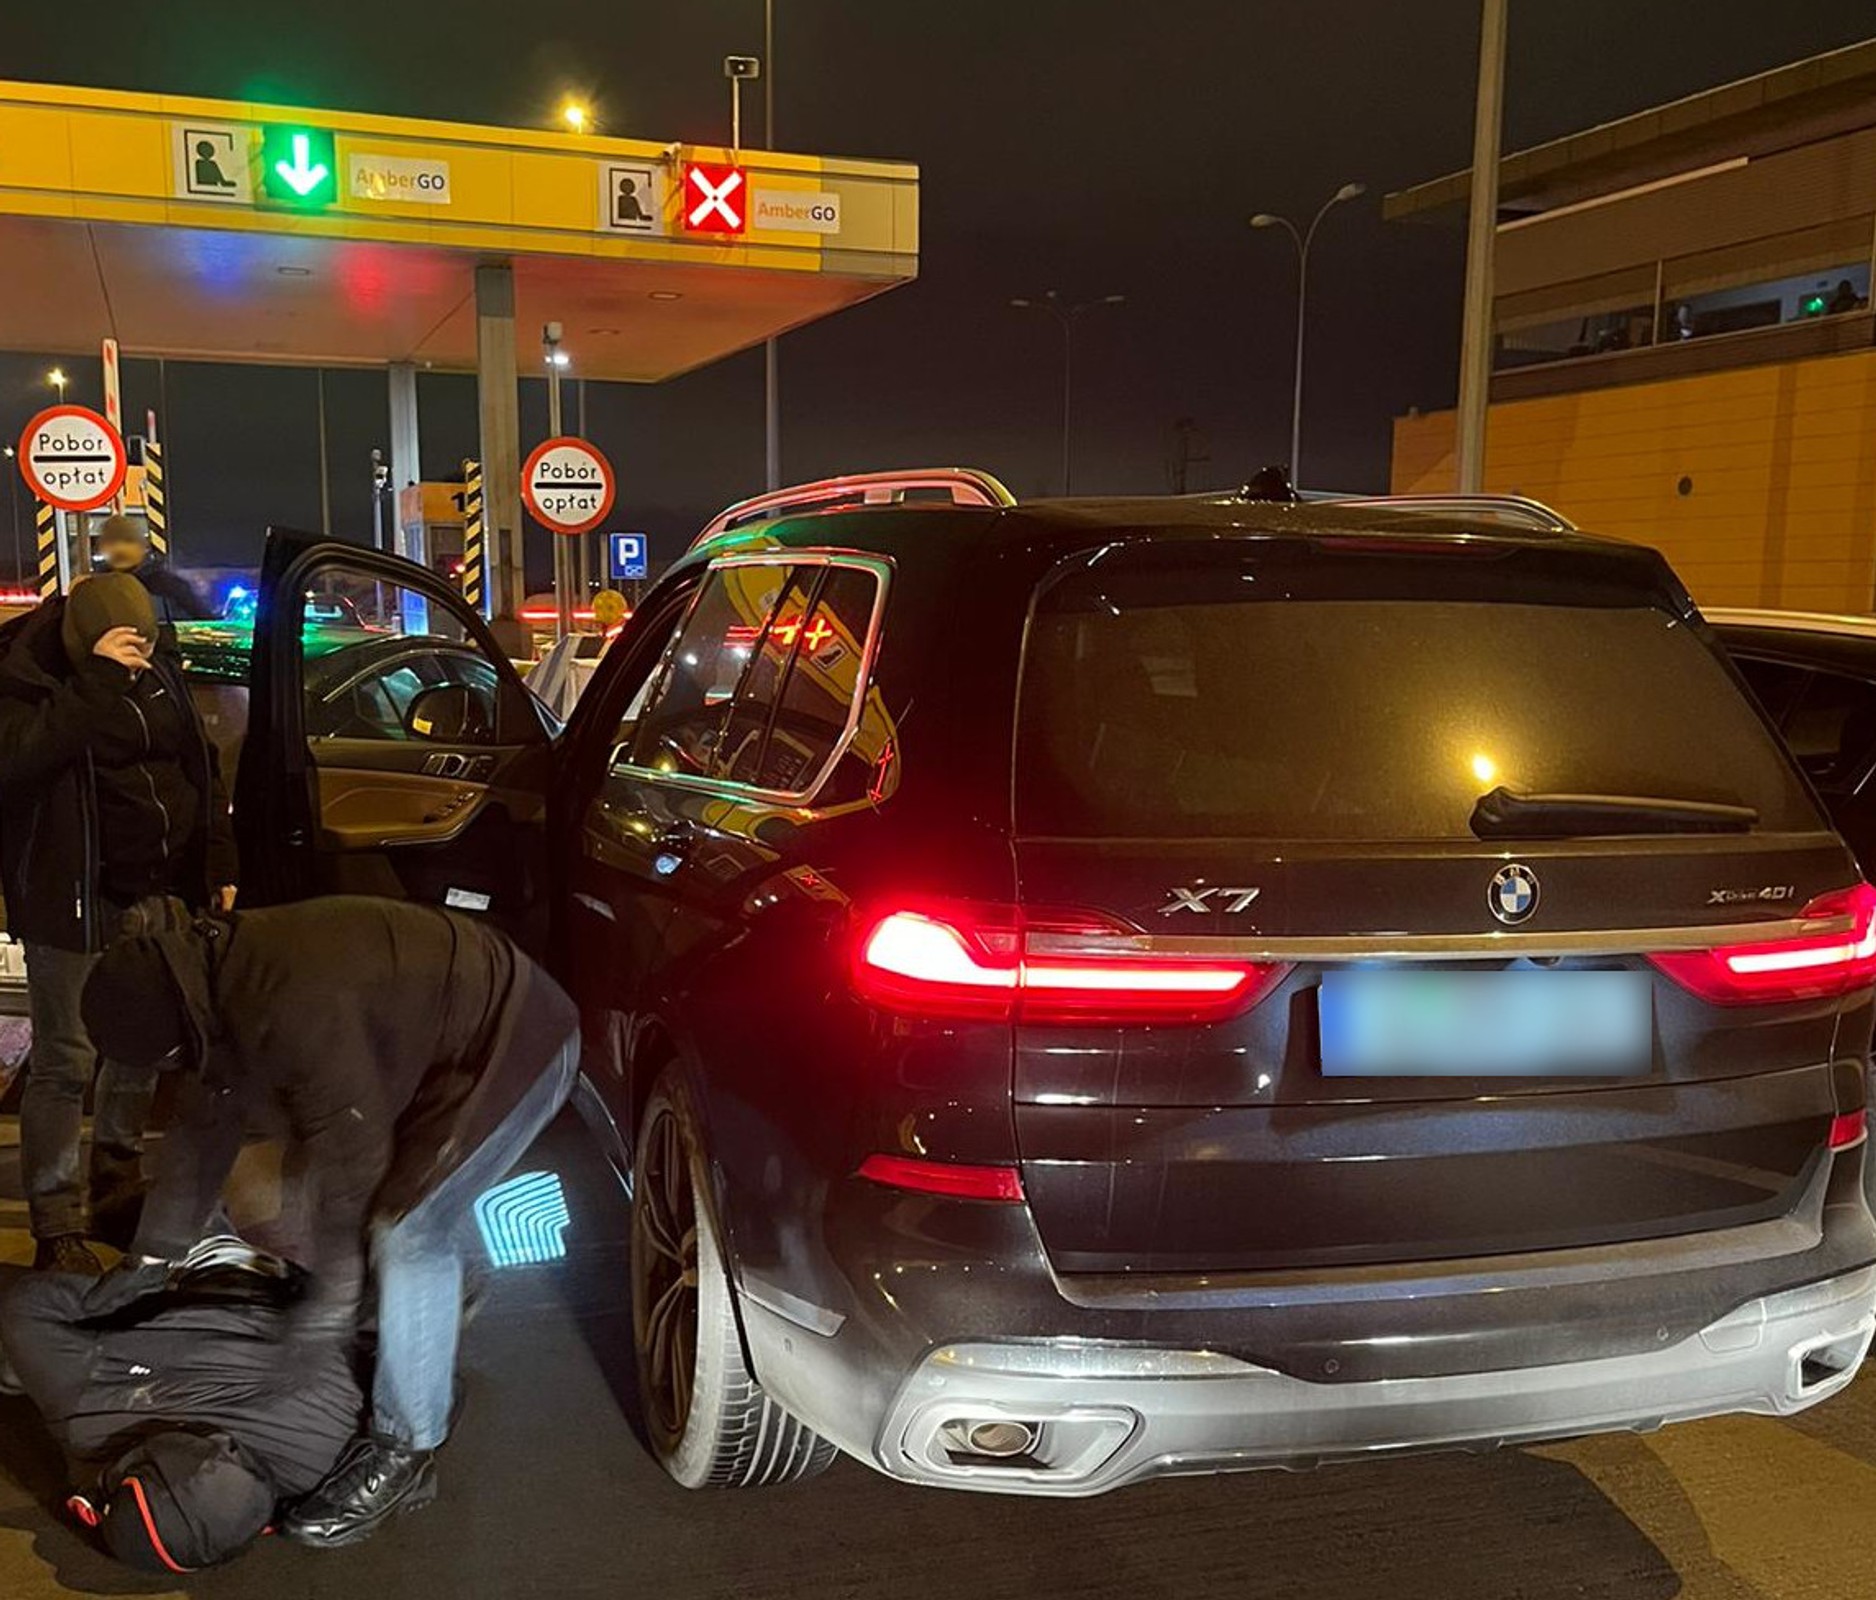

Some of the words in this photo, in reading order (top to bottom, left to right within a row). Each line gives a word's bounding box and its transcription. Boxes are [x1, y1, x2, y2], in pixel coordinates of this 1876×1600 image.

[757, 201, 836, 221] AmberGO
[43, 467, 106, 490] opłat
[542, 494, 597, 514] opłat
[618, 538, 639, 566] P
[1157, 888, 1261, 912] X7
